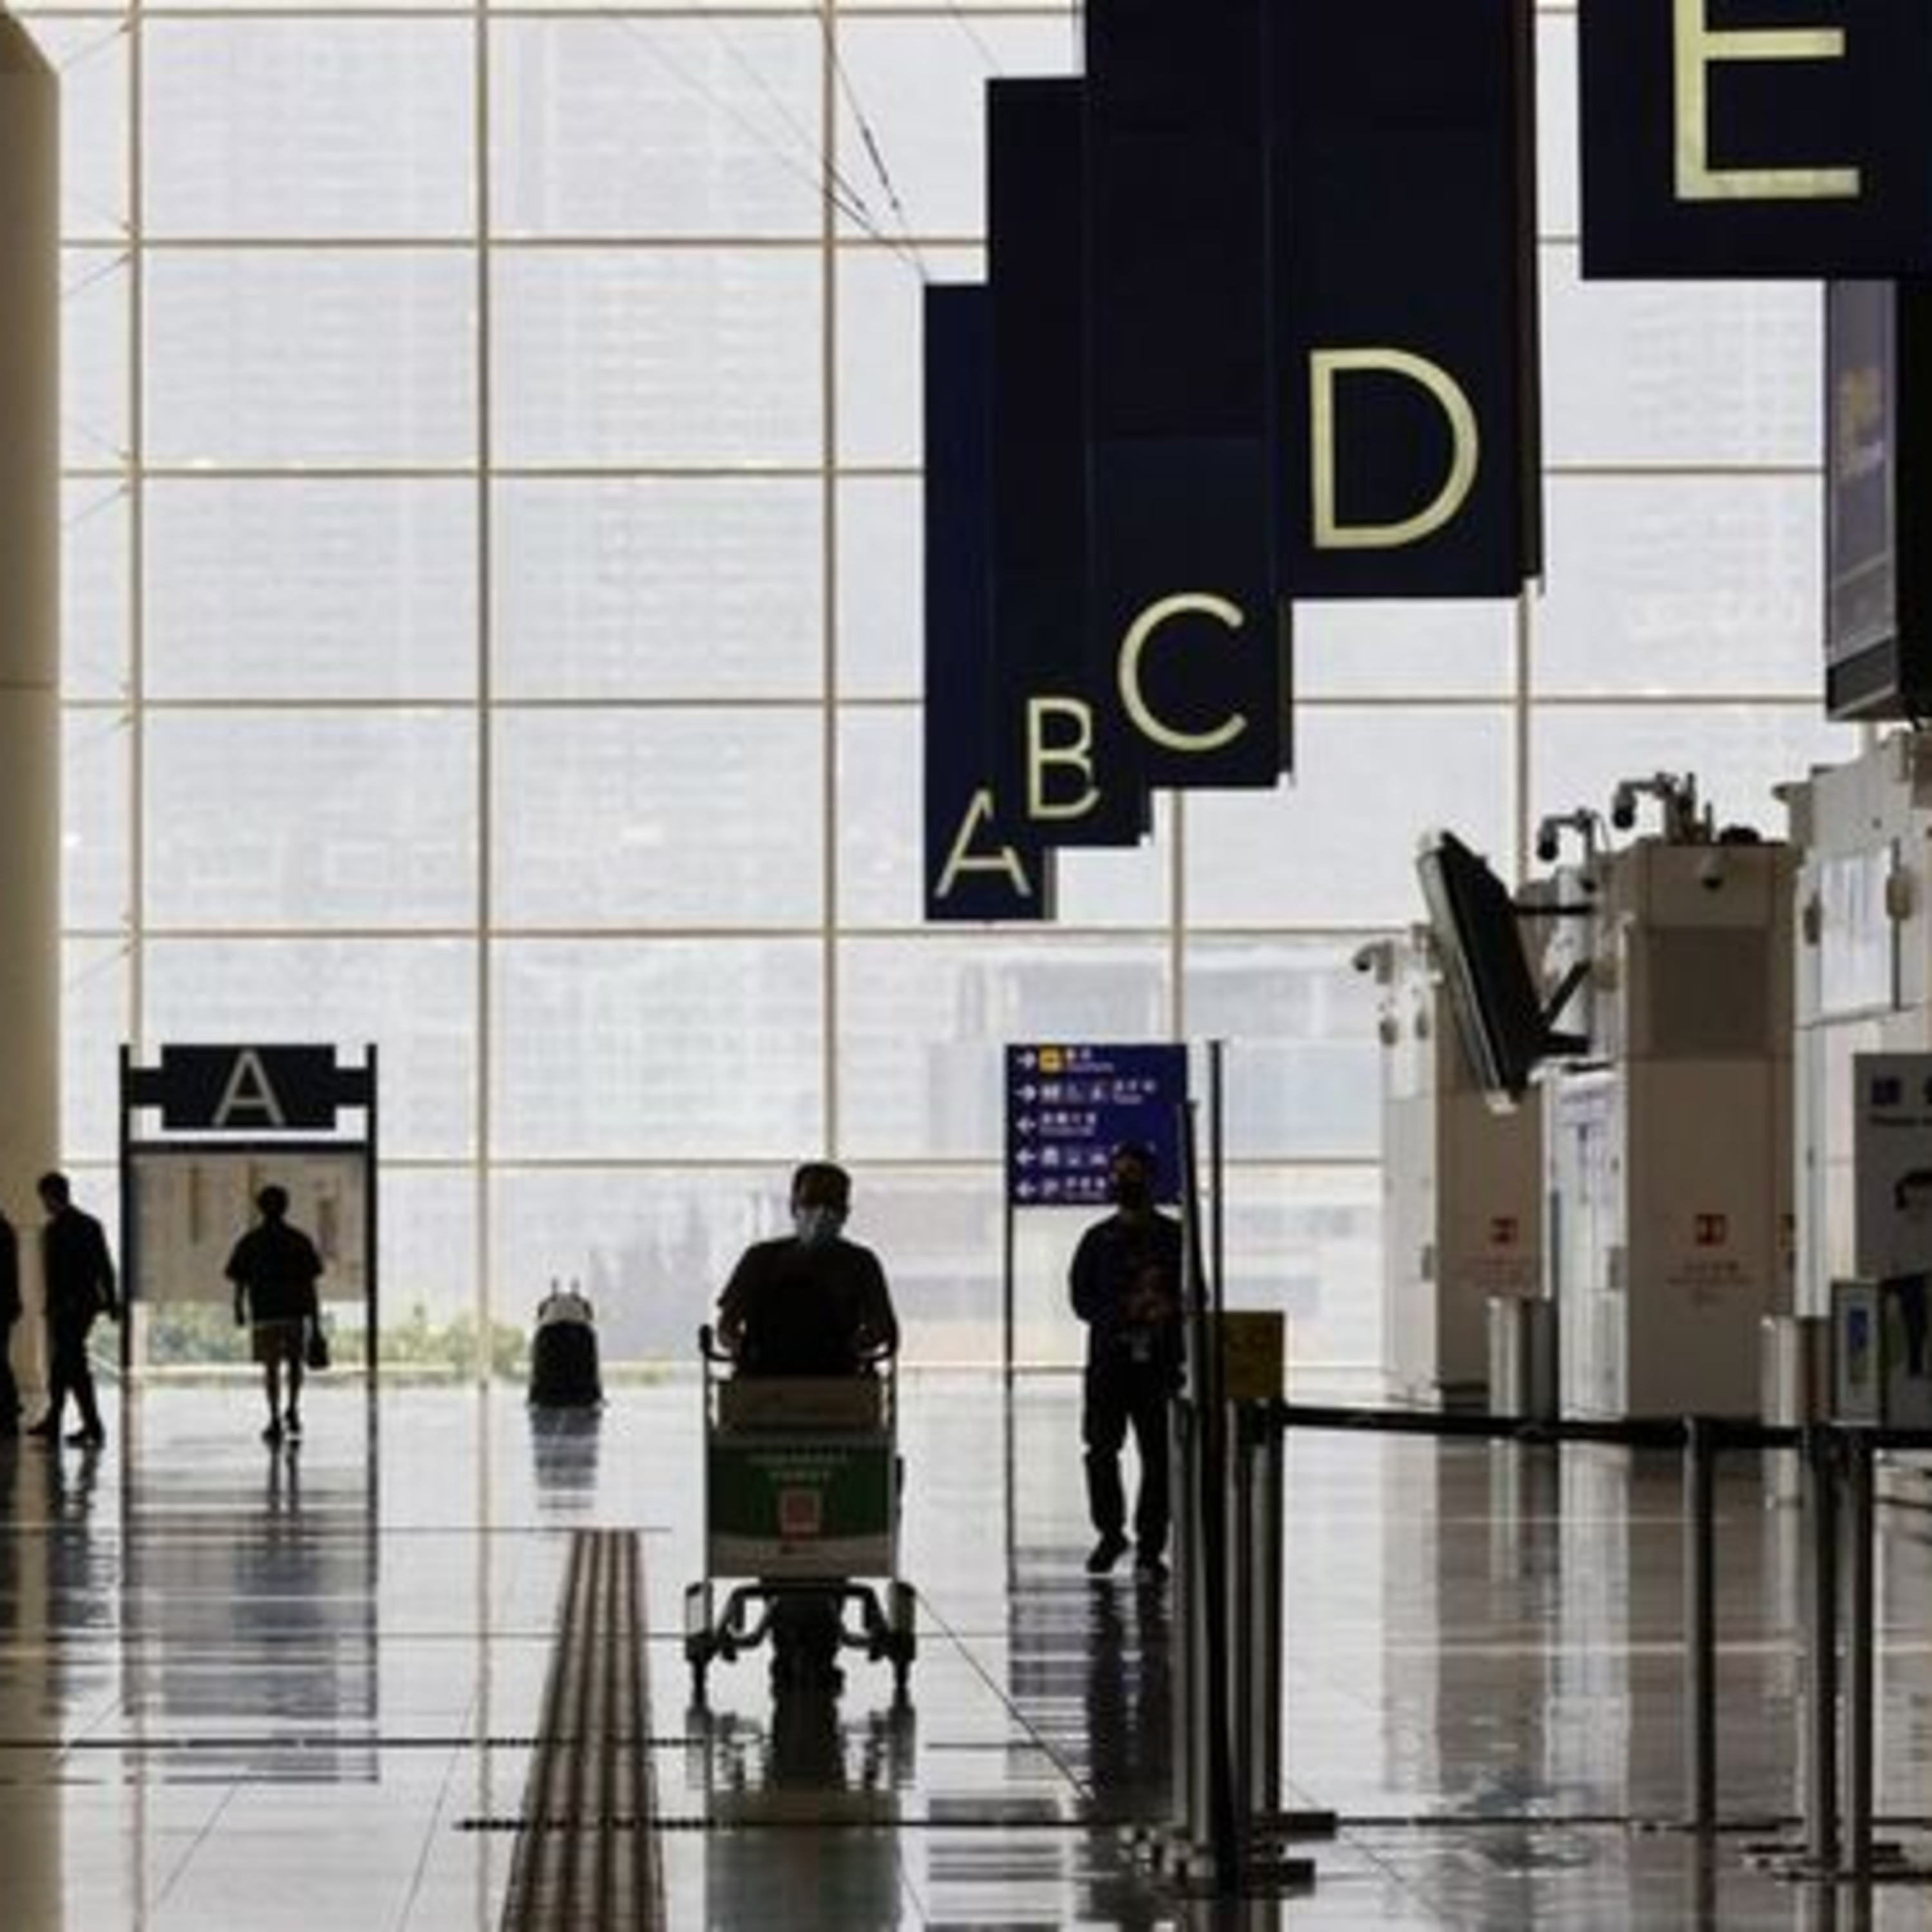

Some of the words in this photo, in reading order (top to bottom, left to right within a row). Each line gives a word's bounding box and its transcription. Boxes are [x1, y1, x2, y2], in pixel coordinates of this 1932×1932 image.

[1310, 348, 1478, 547] D
[1118, 592, 1246, 750] C
[1028, 697, 1099, 818] B
[935, 790, 1030, 897] A
[212, 1050, 285, 1128] A
